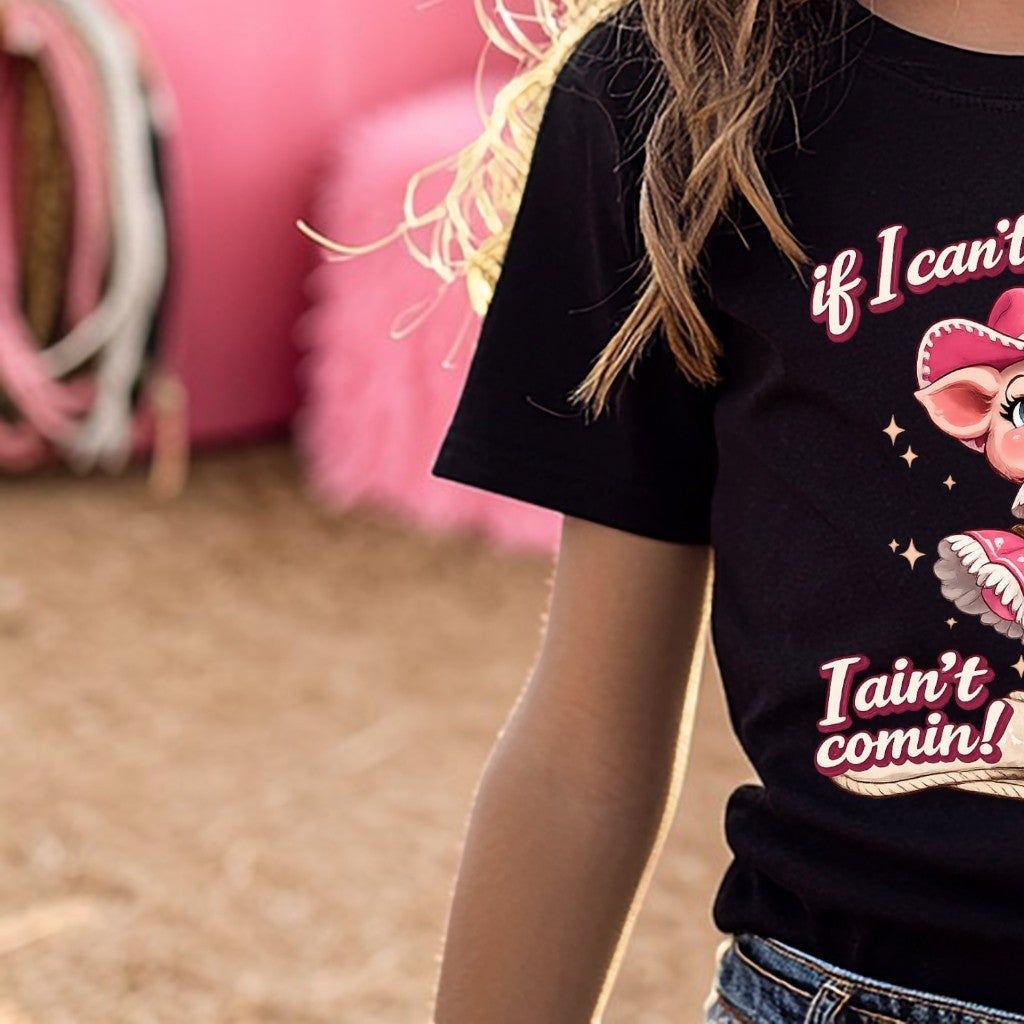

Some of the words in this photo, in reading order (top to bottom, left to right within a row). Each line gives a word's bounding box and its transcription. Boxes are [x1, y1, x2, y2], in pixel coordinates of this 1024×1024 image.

[809, 247, 864, 337] if
[868, 223, 905, 308] I
[817, 655, 864, 729] I
[852, 649, 991, 714] ain't
[814, 698, 1011, 771] comin!
